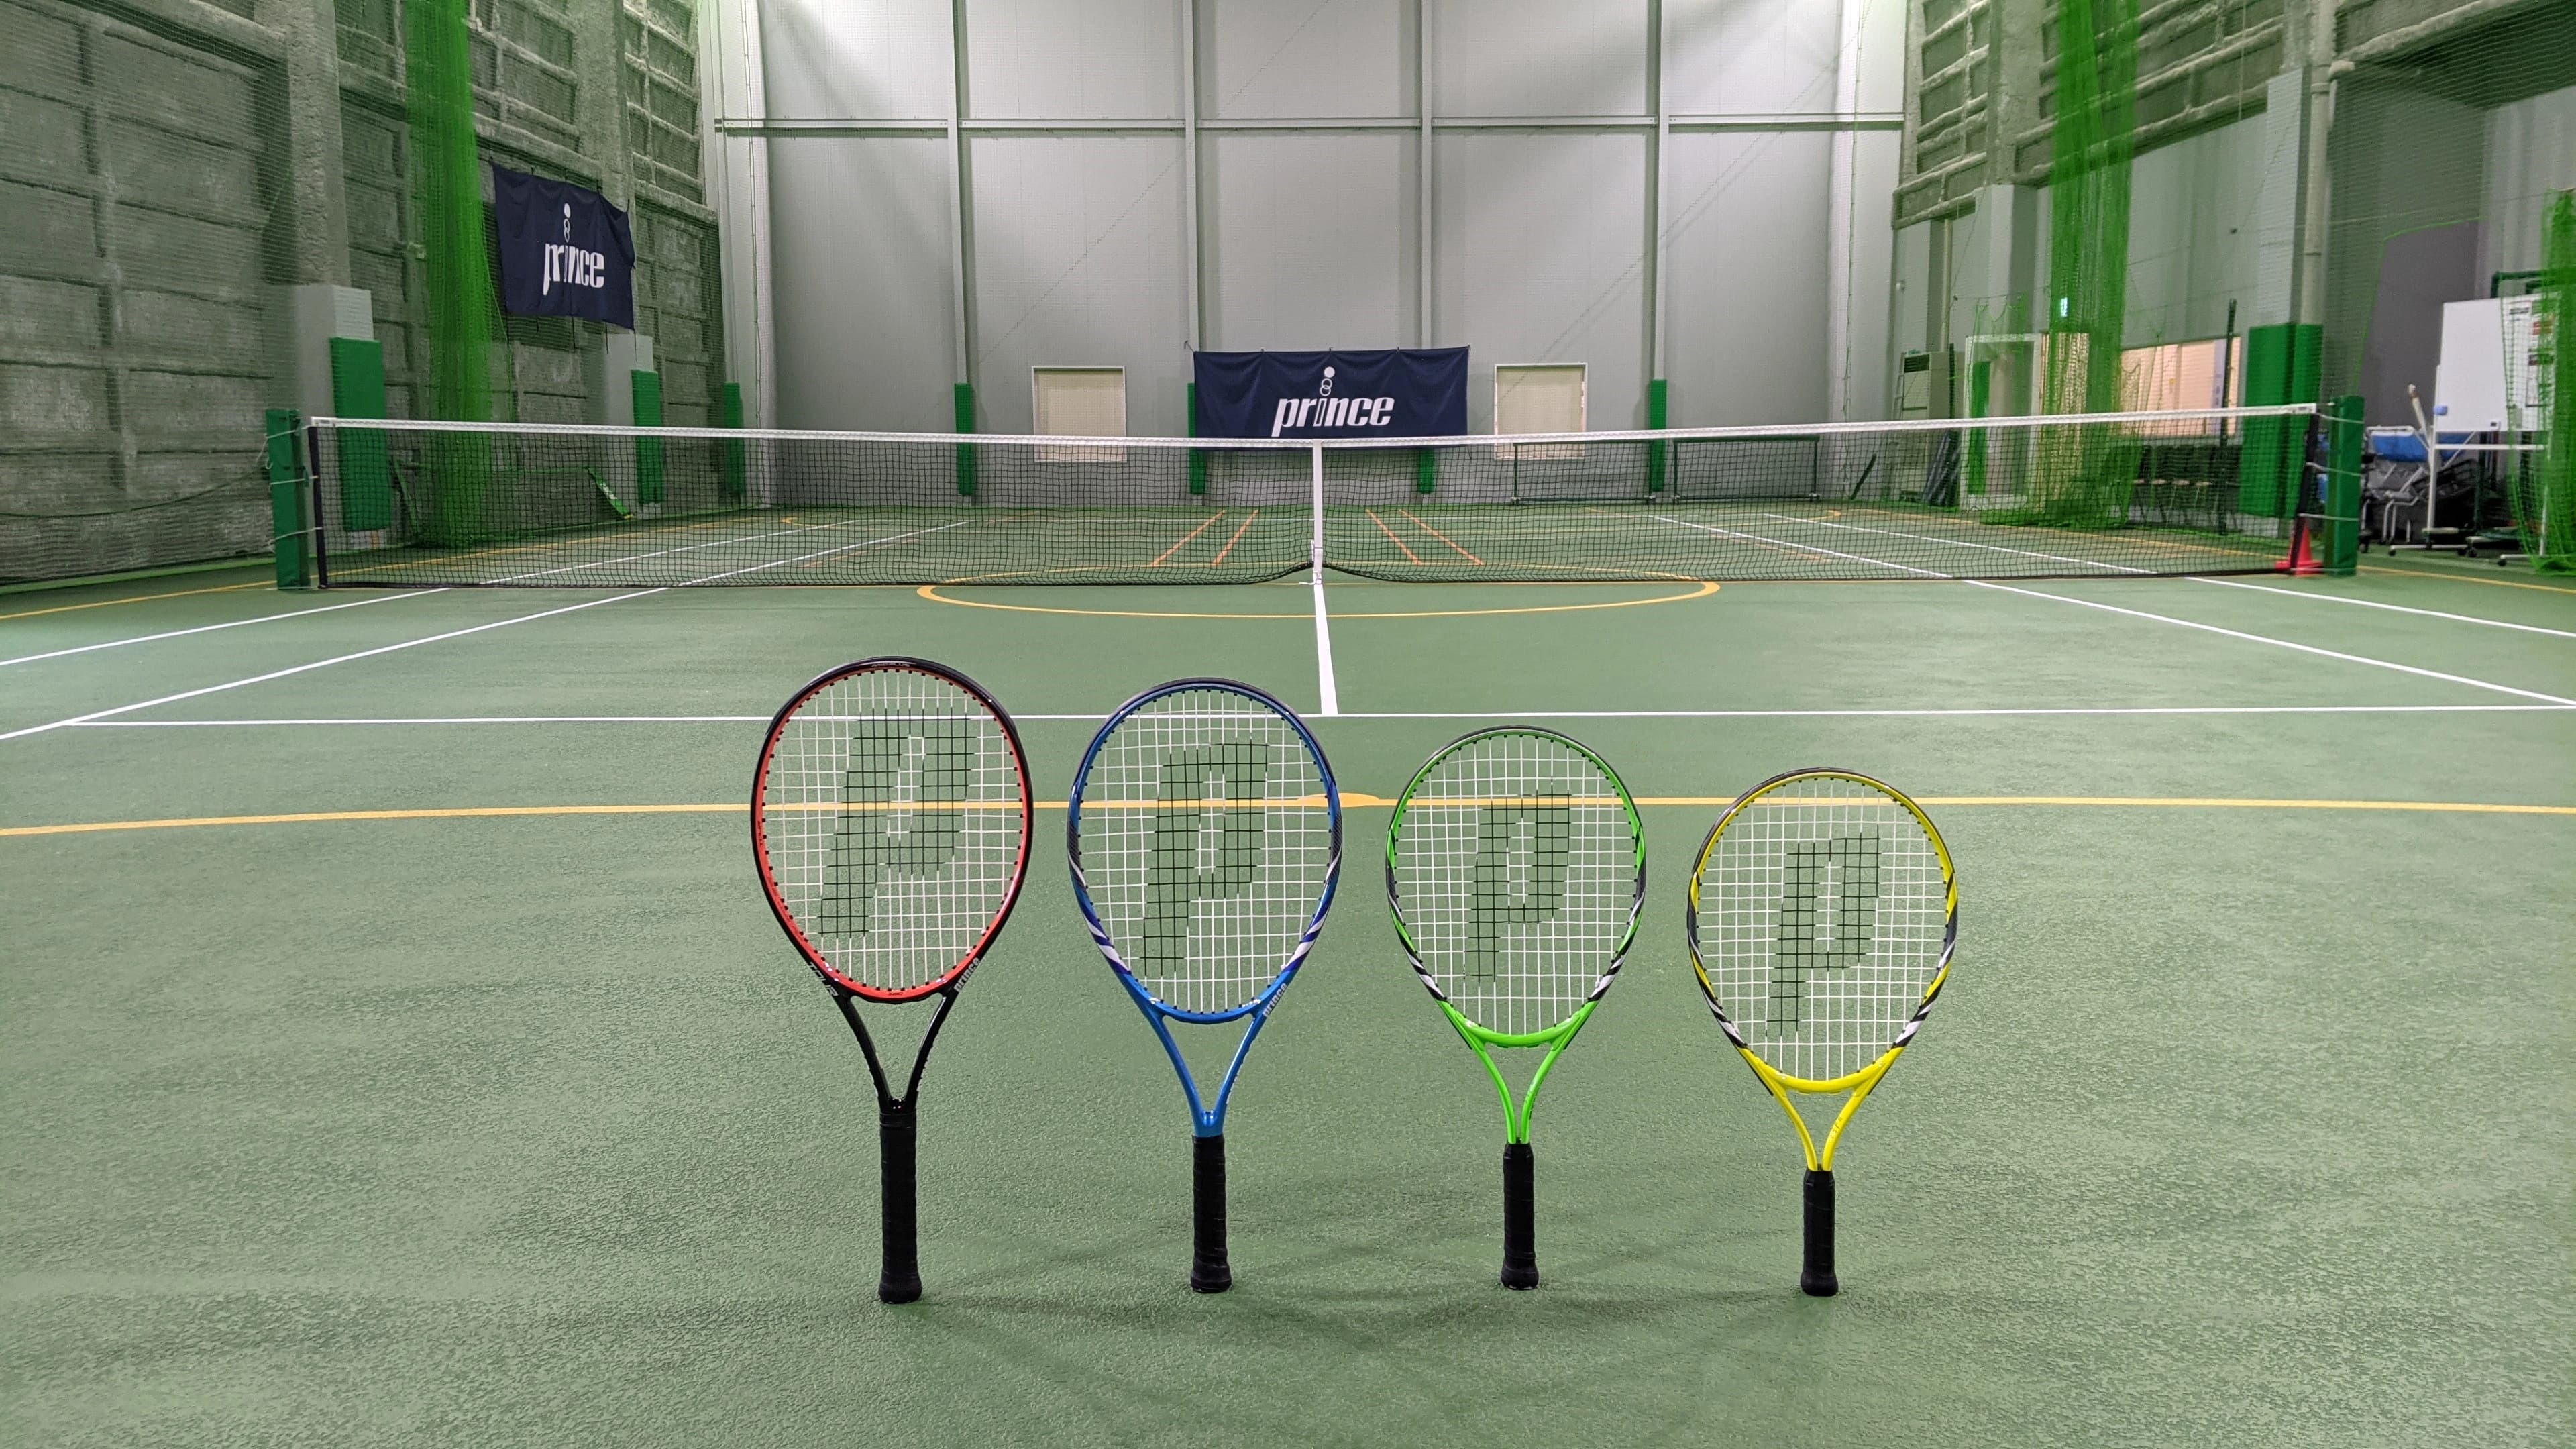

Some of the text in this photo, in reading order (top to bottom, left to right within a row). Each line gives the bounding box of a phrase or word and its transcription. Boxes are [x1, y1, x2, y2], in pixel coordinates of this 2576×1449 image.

[543, 203, 604, 296] prince
[1271, 366, 1395, 437] prince
[809, 961, 839, 996] TOUR
